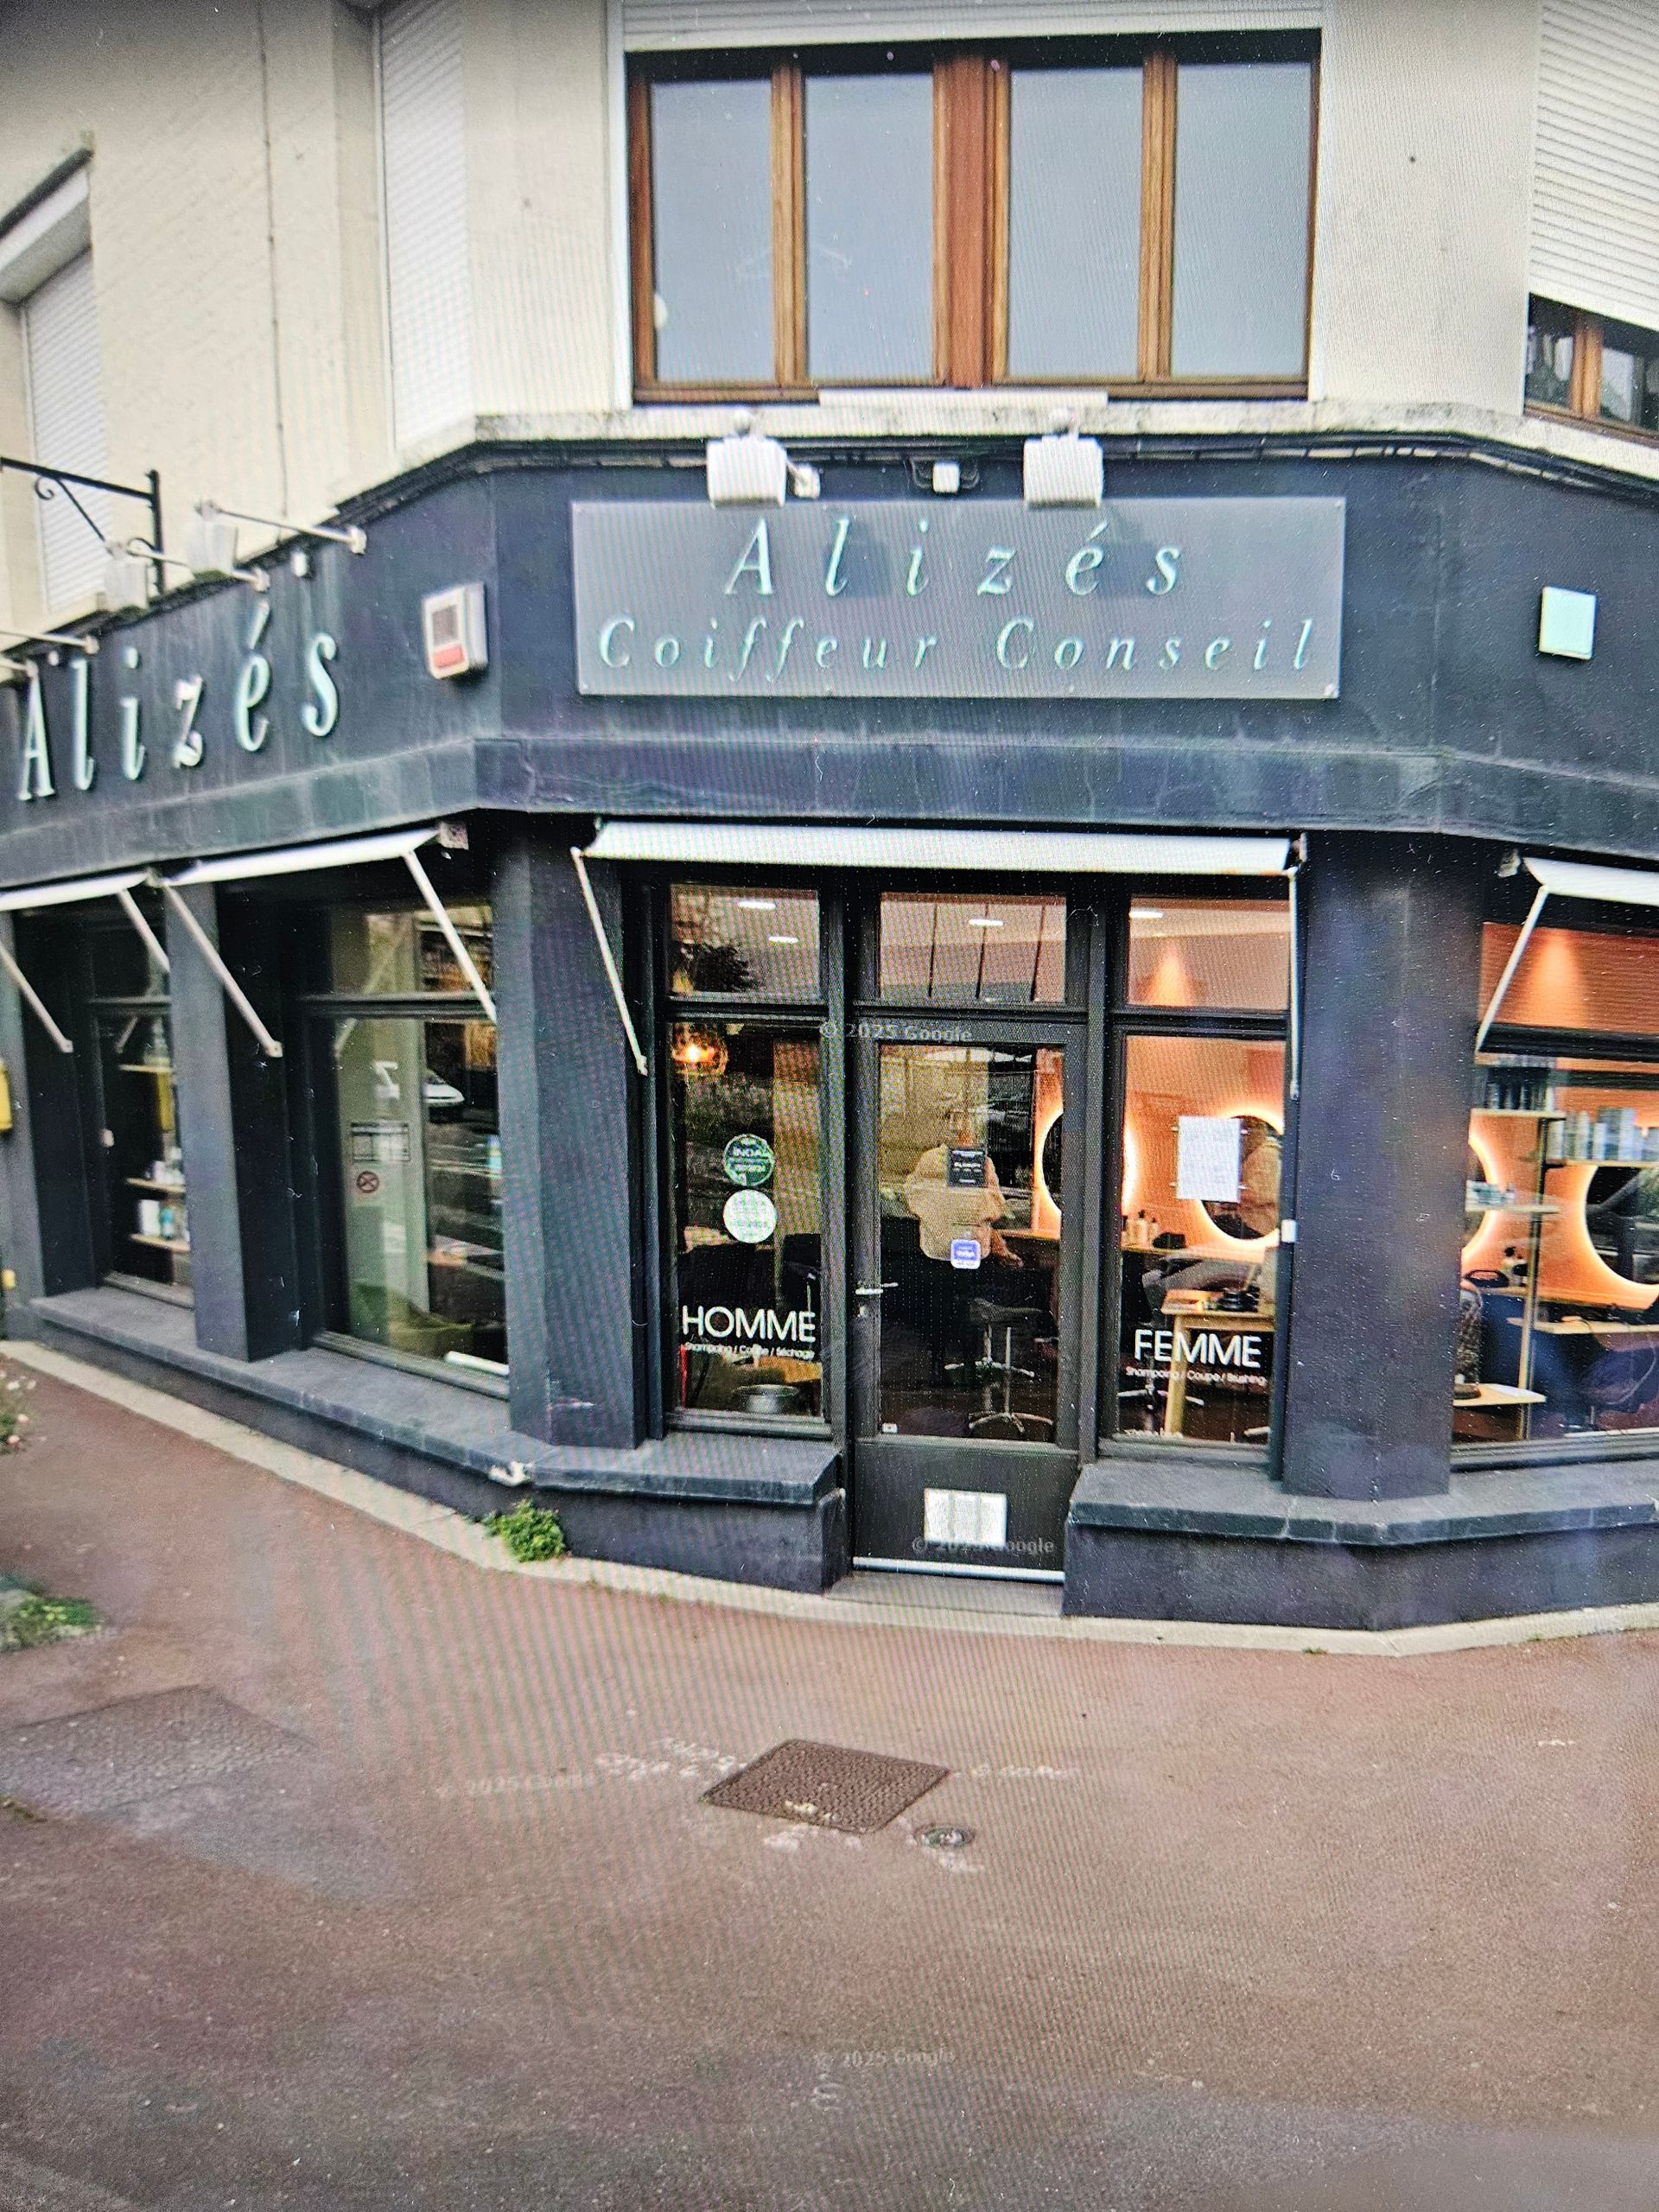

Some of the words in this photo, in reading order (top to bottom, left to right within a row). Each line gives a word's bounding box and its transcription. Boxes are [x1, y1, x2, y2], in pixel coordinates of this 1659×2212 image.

[724, 517, 1183, 597] Alizés
[598, 614, 938, 683] Coiffeur
[996, 614, 1313, 671] Conseil
[19, 601, 339, 801] Alizés
[682, 1305, 817, 1344] HOMME
[1135, 1329, 1262, 1368] FEMME
